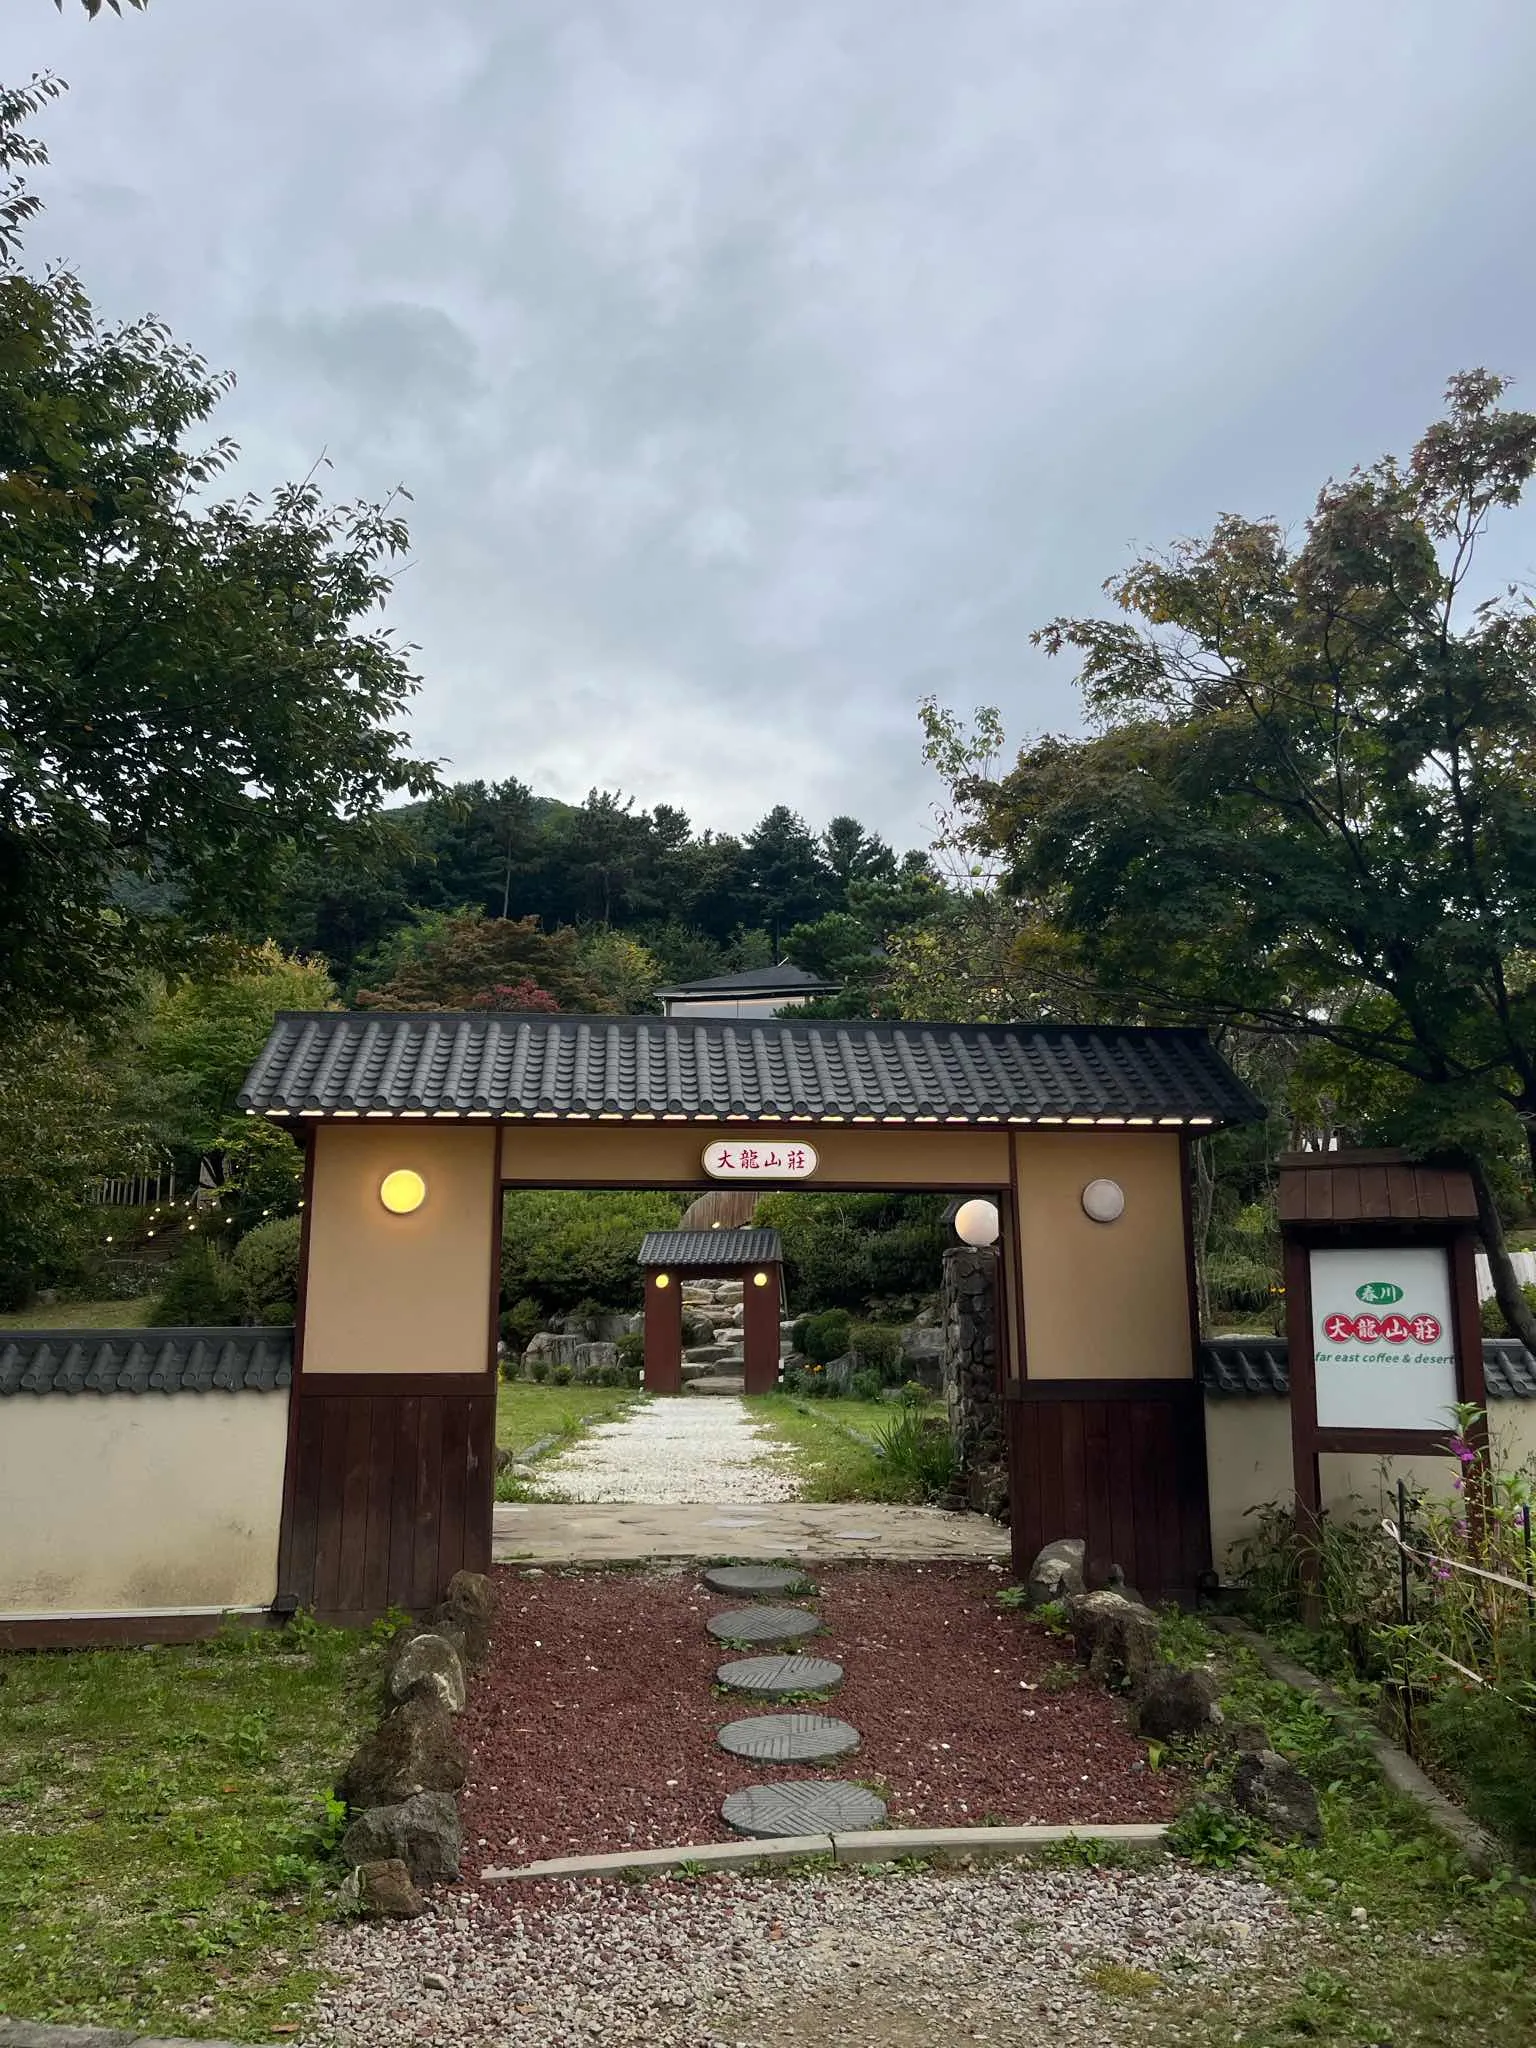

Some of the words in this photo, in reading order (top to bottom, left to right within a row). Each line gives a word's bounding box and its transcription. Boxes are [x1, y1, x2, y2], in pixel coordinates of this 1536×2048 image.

[718, 1150, 805, 1170] 大龍山莊
[1361, 1285, 1397, 1301] 春川
[1329, 1318, 1437, 1340] 大龍山莊
[1315, 1352, 1332, 1363] far
[1334, 1354, 1360, 1363] east
[1363, 1352, 1400, 1363] coffee
[1402, 1354, 1411, 1363] &
[1414, 1353, 1455, 1365] desert
